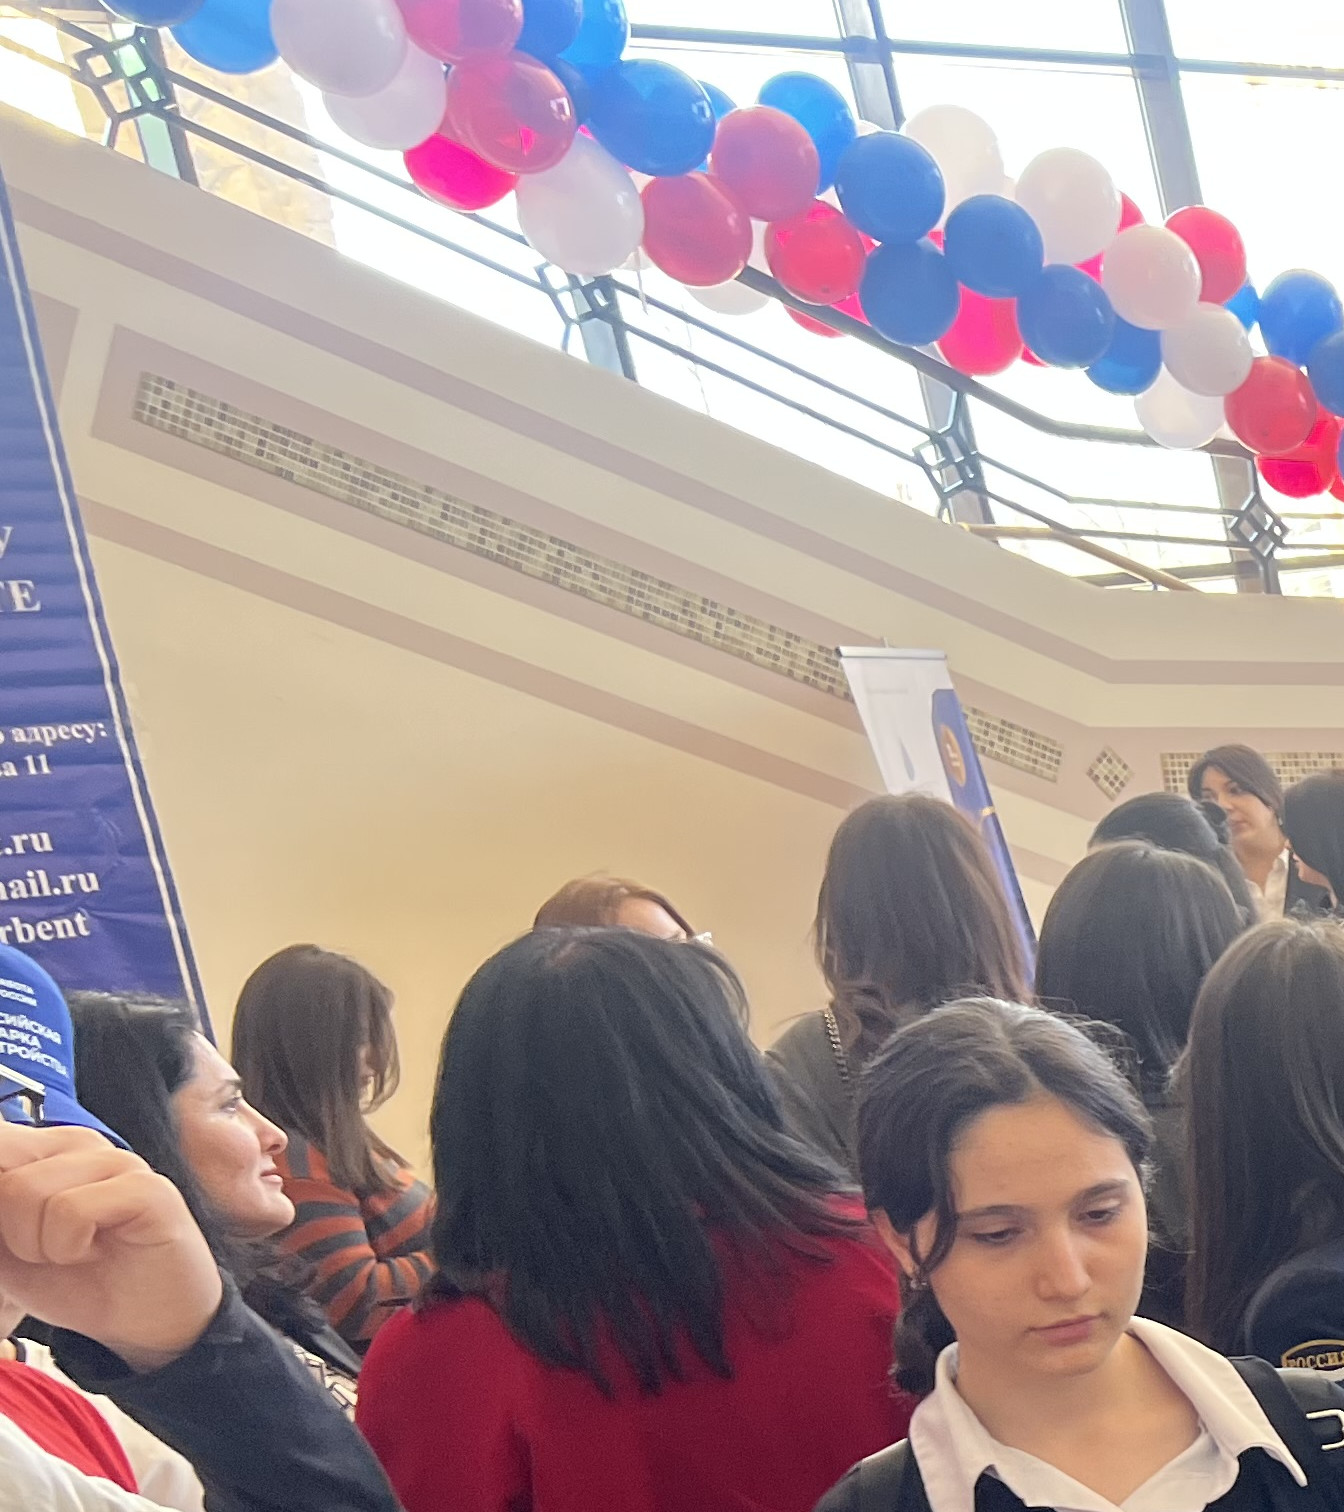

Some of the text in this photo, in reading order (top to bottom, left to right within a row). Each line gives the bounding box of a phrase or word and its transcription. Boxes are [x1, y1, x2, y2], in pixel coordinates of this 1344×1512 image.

[12, 722, 108, 747] адресу:
[24, 754, 51, 775] 11
[0, 831, 53, 856] .ru
[0, 869, 100, 901] ail.ru
